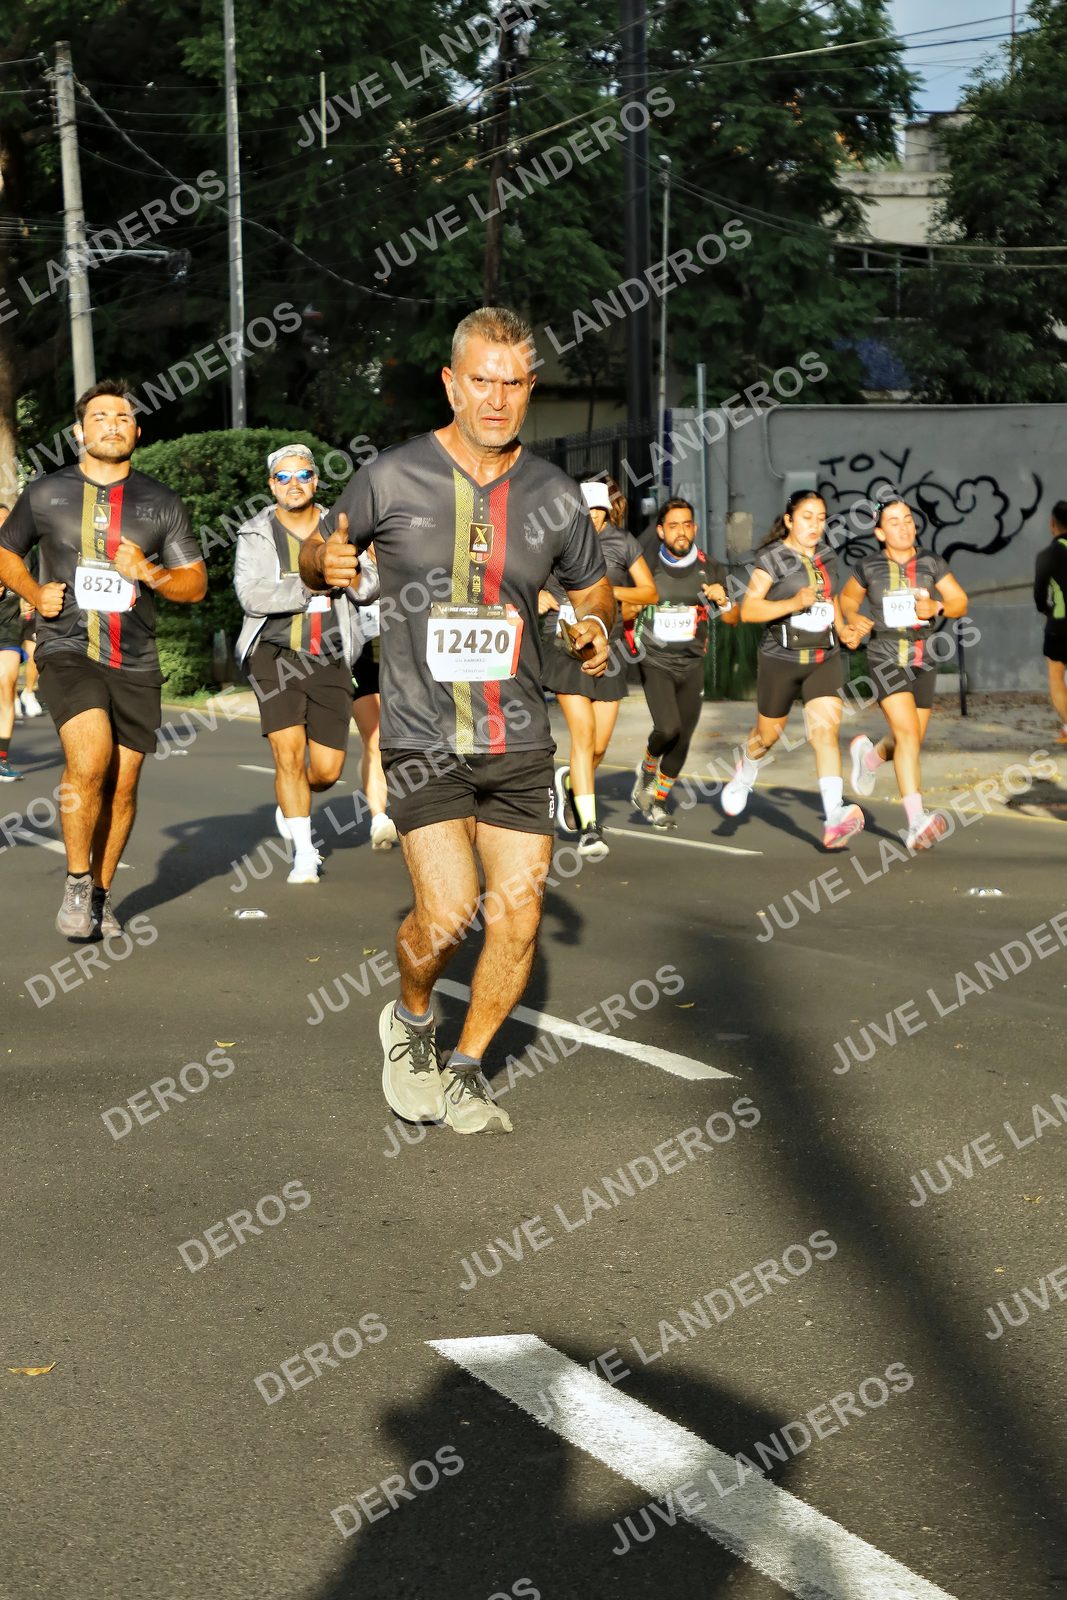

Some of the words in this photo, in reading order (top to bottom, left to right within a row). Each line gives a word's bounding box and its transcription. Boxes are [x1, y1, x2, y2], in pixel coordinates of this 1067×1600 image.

[819, 448, 911, 484] TOY
[82, 575, 123, 594] 8521
[433, 629, 510, 654] 12420
